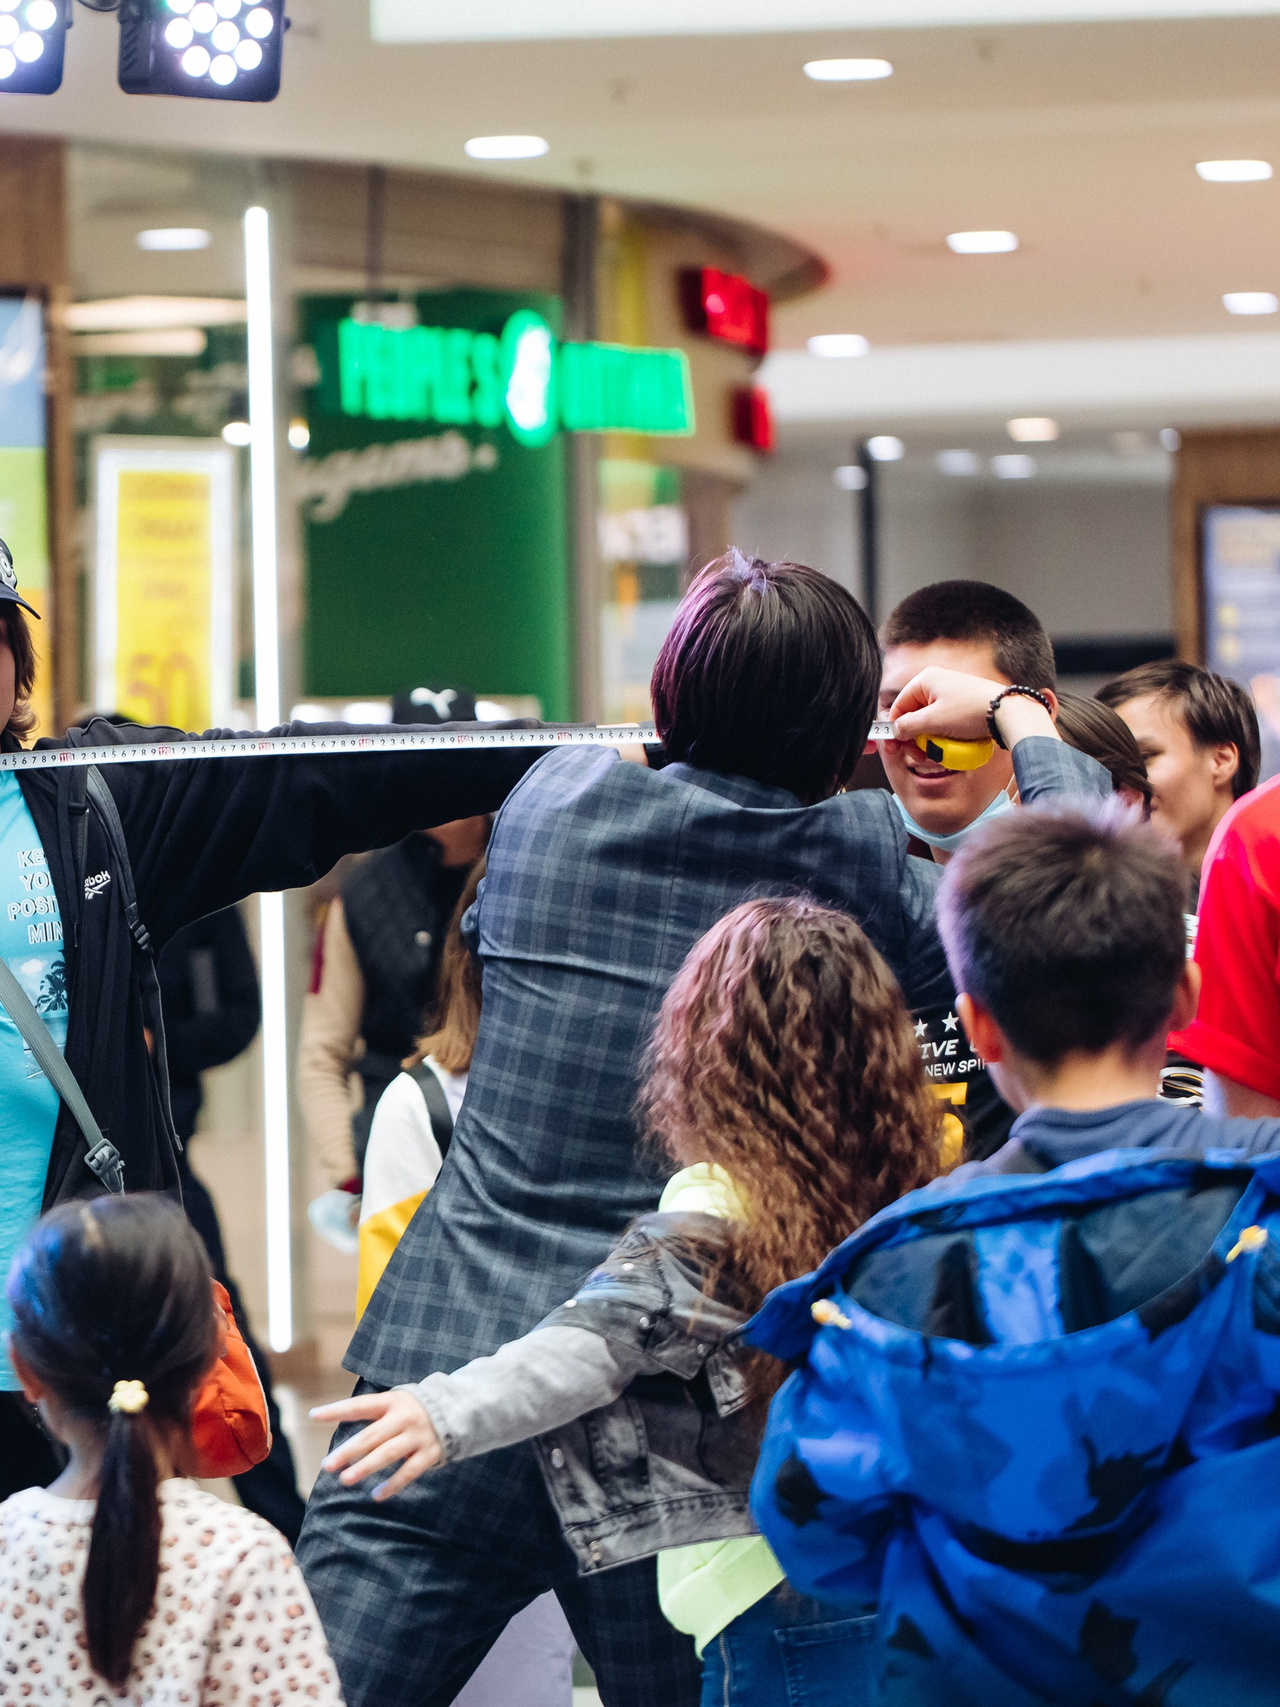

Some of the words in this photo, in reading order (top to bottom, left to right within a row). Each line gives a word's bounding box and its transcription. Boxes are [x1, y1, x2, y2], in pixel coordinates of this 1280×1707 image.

[17, 848, 48, 869] KE
[84, 870, 111, 887] ebok
[27, 921, 64, 944] MIN
[920, 1038, 960, 1059] IVE
[924, 1062, 956, 1077] NEW
